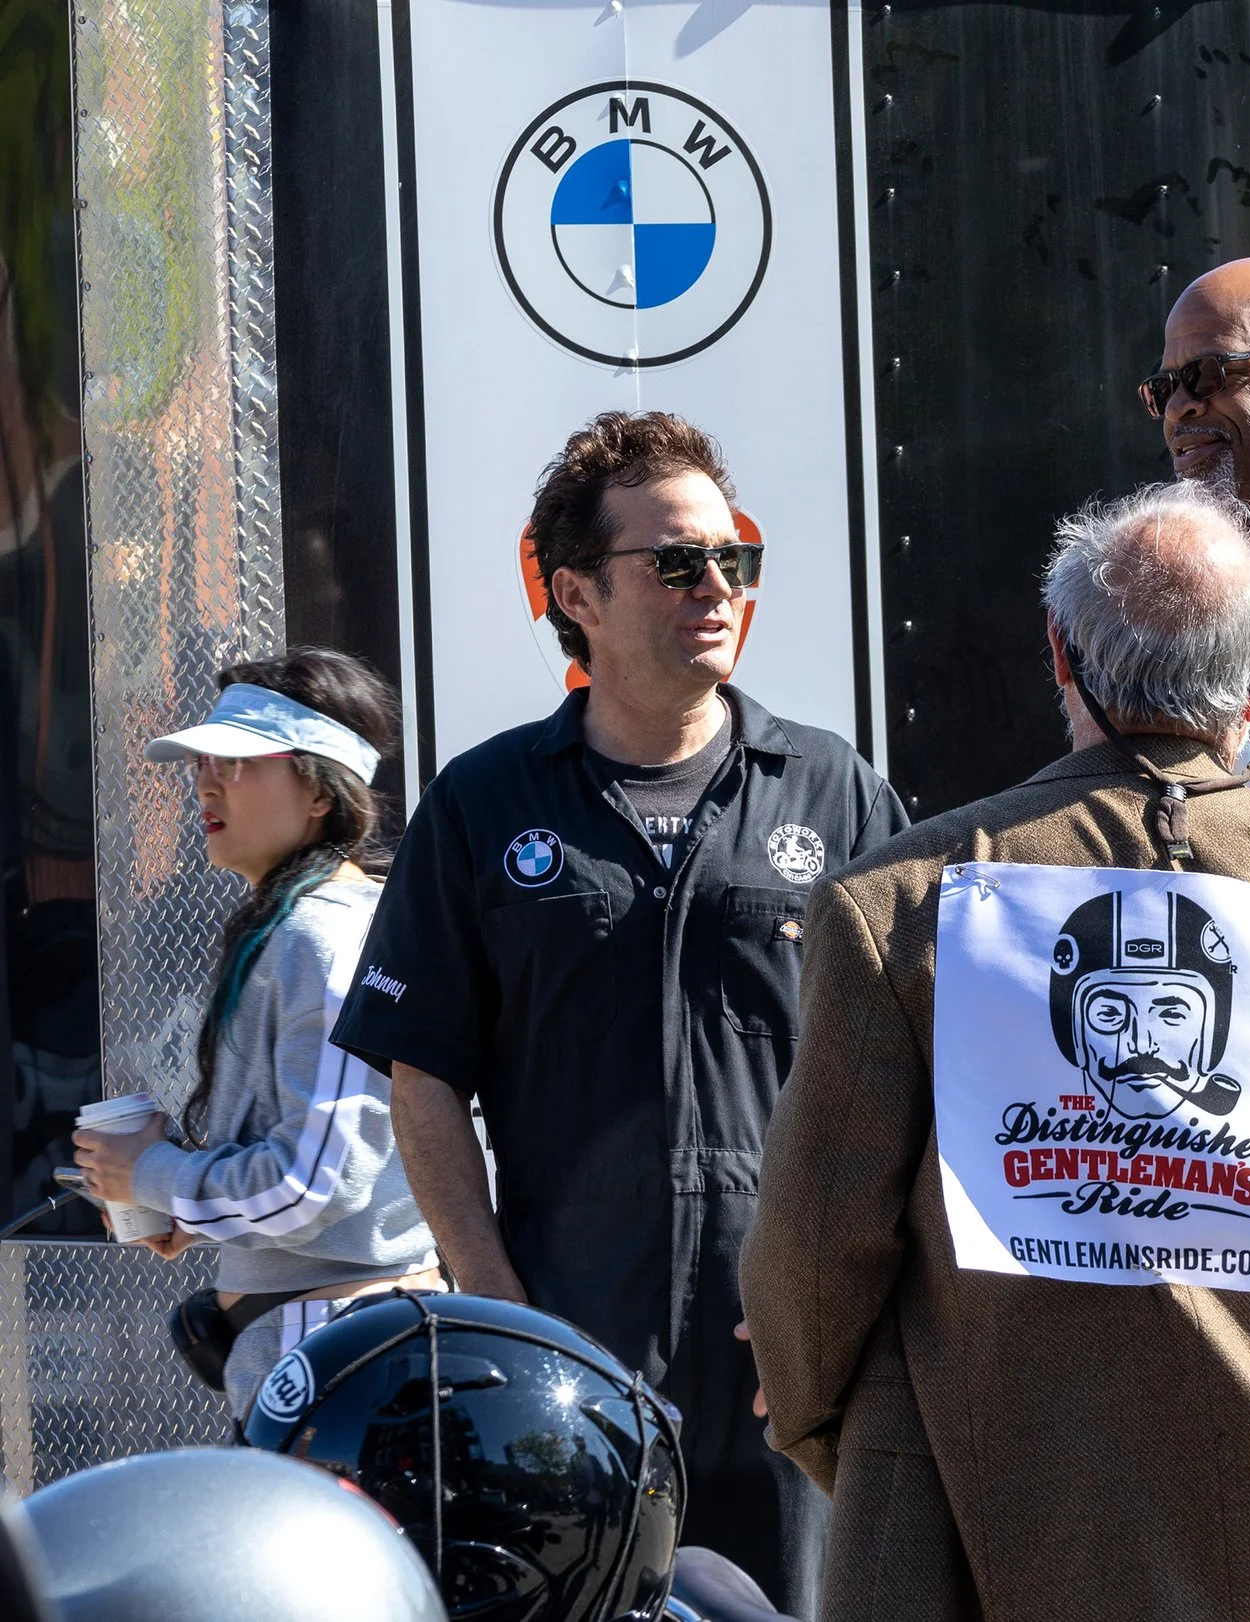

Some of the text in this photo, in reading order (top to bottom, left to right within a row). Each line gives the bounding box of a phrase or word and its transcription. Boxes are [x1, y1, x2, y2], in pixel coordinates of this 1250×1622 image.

[530, 97, 732, 174] BMW
[512, 832, 556, 853] BMW
[1127, 942, 1162, 955] DGR
[361, 965, 407, 1003] Johnny
[1059, 1094, 1095, 1111] THE
[1061, 1180, 1193, 1221] Ride
